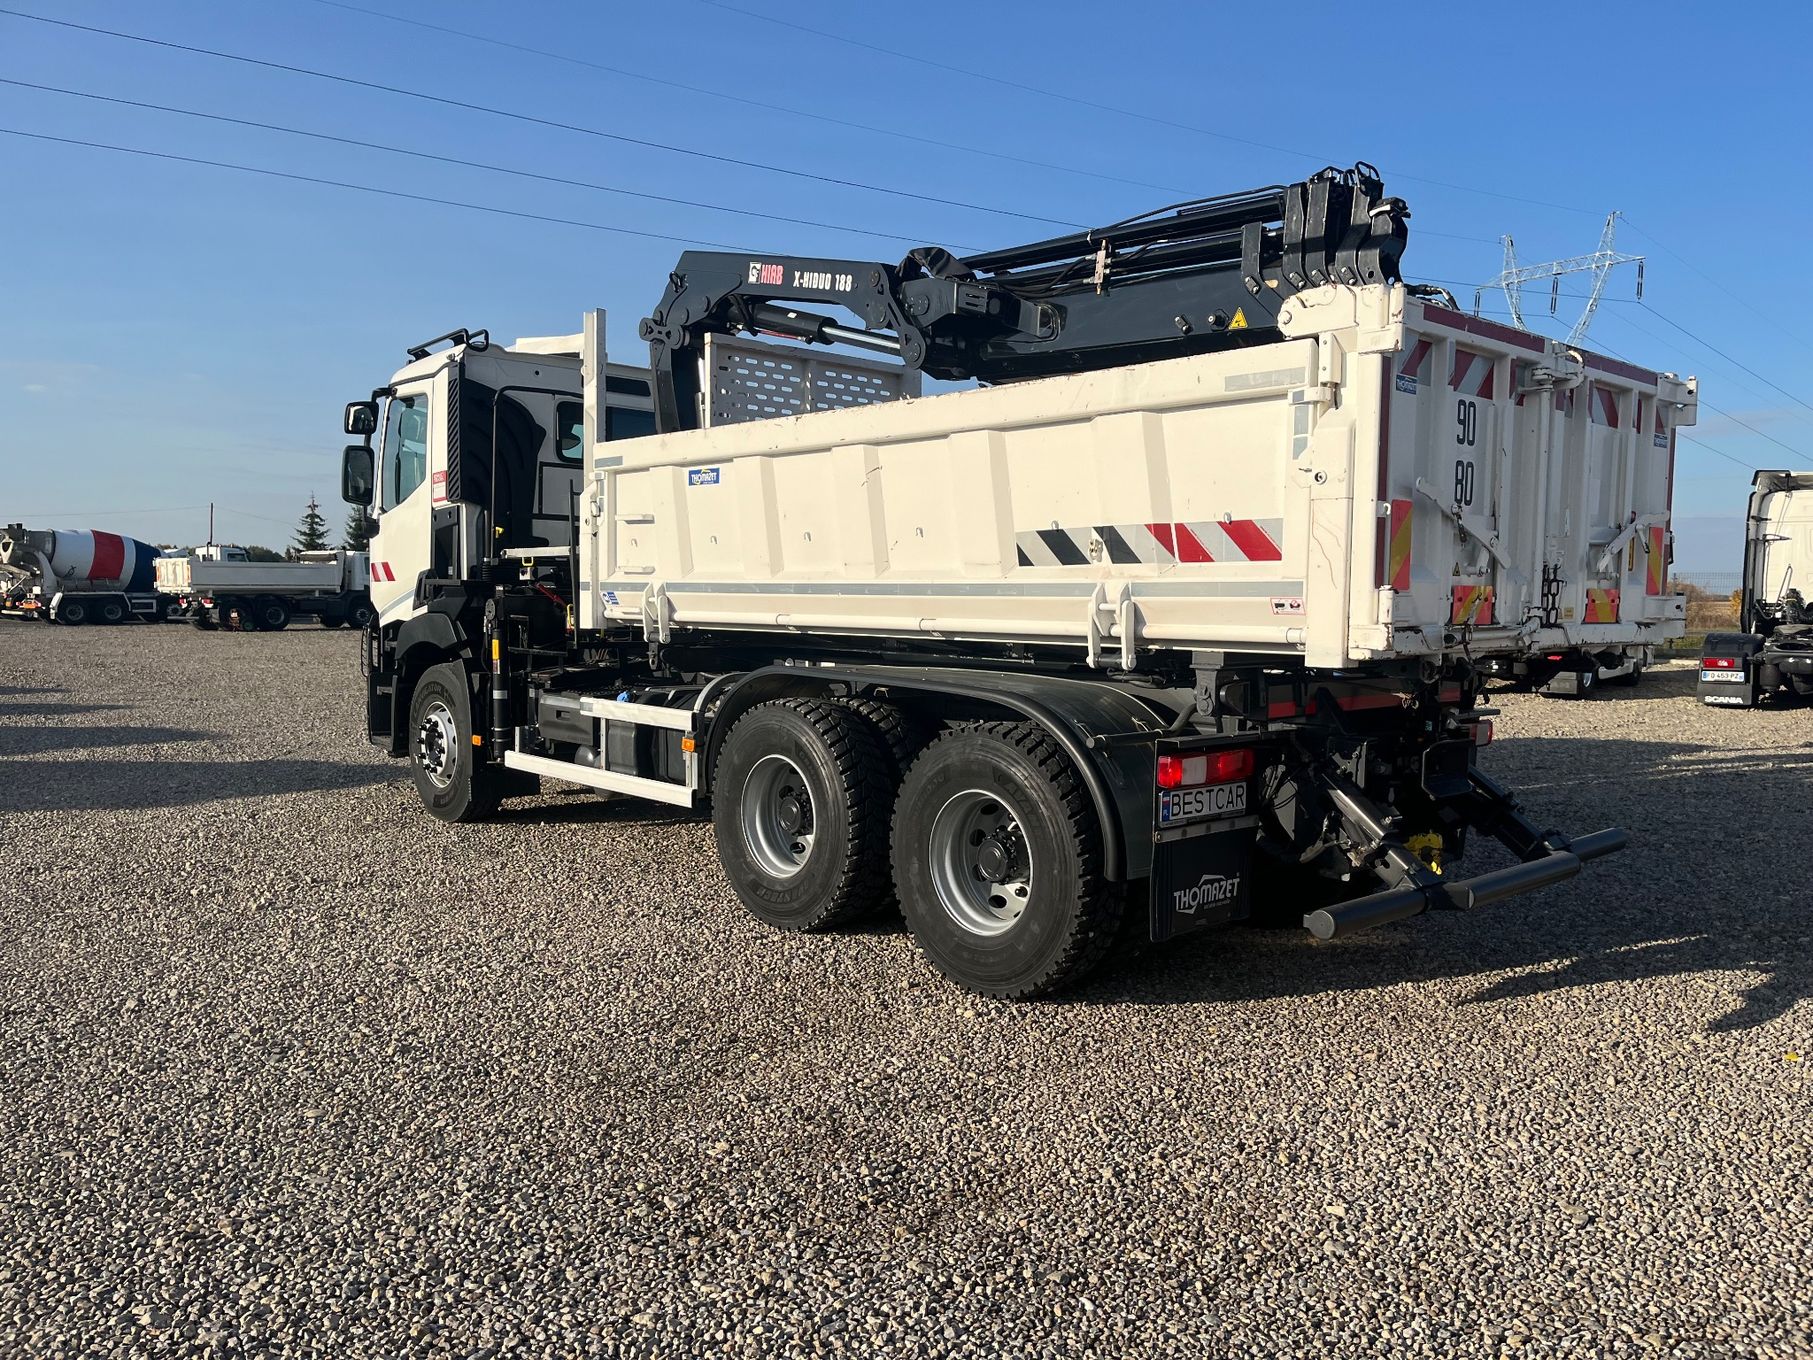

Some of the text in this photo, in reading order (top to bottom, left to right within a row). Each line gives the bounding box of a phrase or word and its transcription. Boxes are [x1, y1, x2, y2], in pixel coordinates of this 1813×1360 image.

[760, 264, 784, 285] HIAB
[793, 270, 853, 292] X-HIDUO 188
[1457, 399, 1476, 446] 90
[1454, 460, 1474, 506] 80
[1704, 695, 1744, 704] SCANIA
[1171, 785, 1245, 817] BESTCAR
[1173, 877, 1240, 910] THOMAZET
